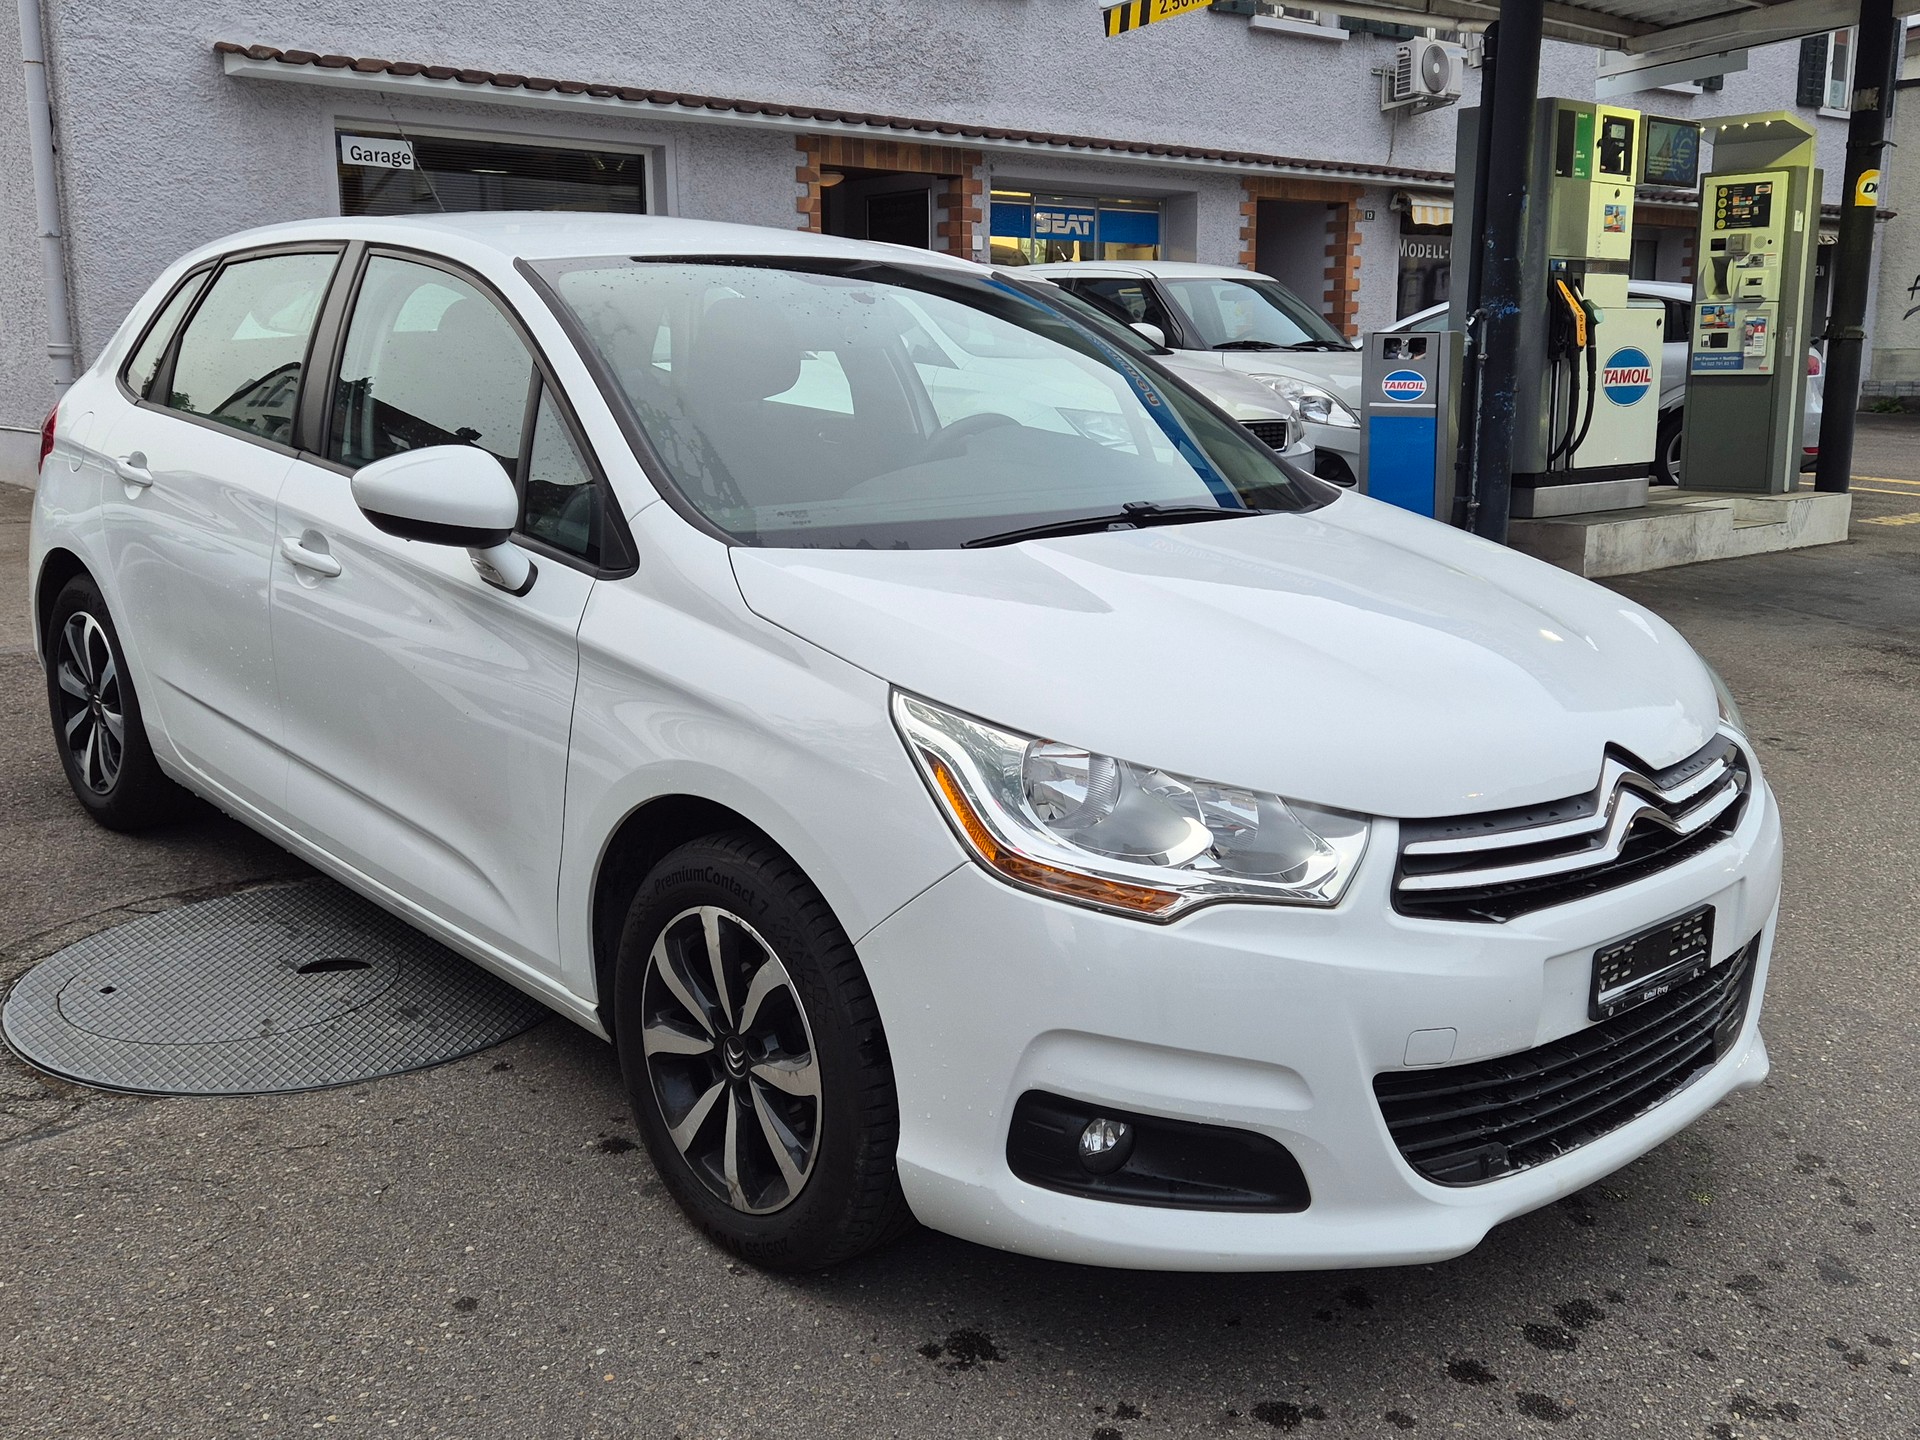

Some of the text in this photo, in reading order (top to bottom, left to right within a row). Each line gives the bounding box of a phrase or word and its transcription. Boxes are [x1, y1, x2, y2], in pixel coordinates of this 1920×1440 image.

[350, 145, 411, 168] Garage
[1035, 212, 1094, 236] SEAT
[1384, 381, 1425, 390] TAMOIL
[1603, 368, 1652, 384] TAMOIL
[654, 865, 756, 907] PremiumContact
